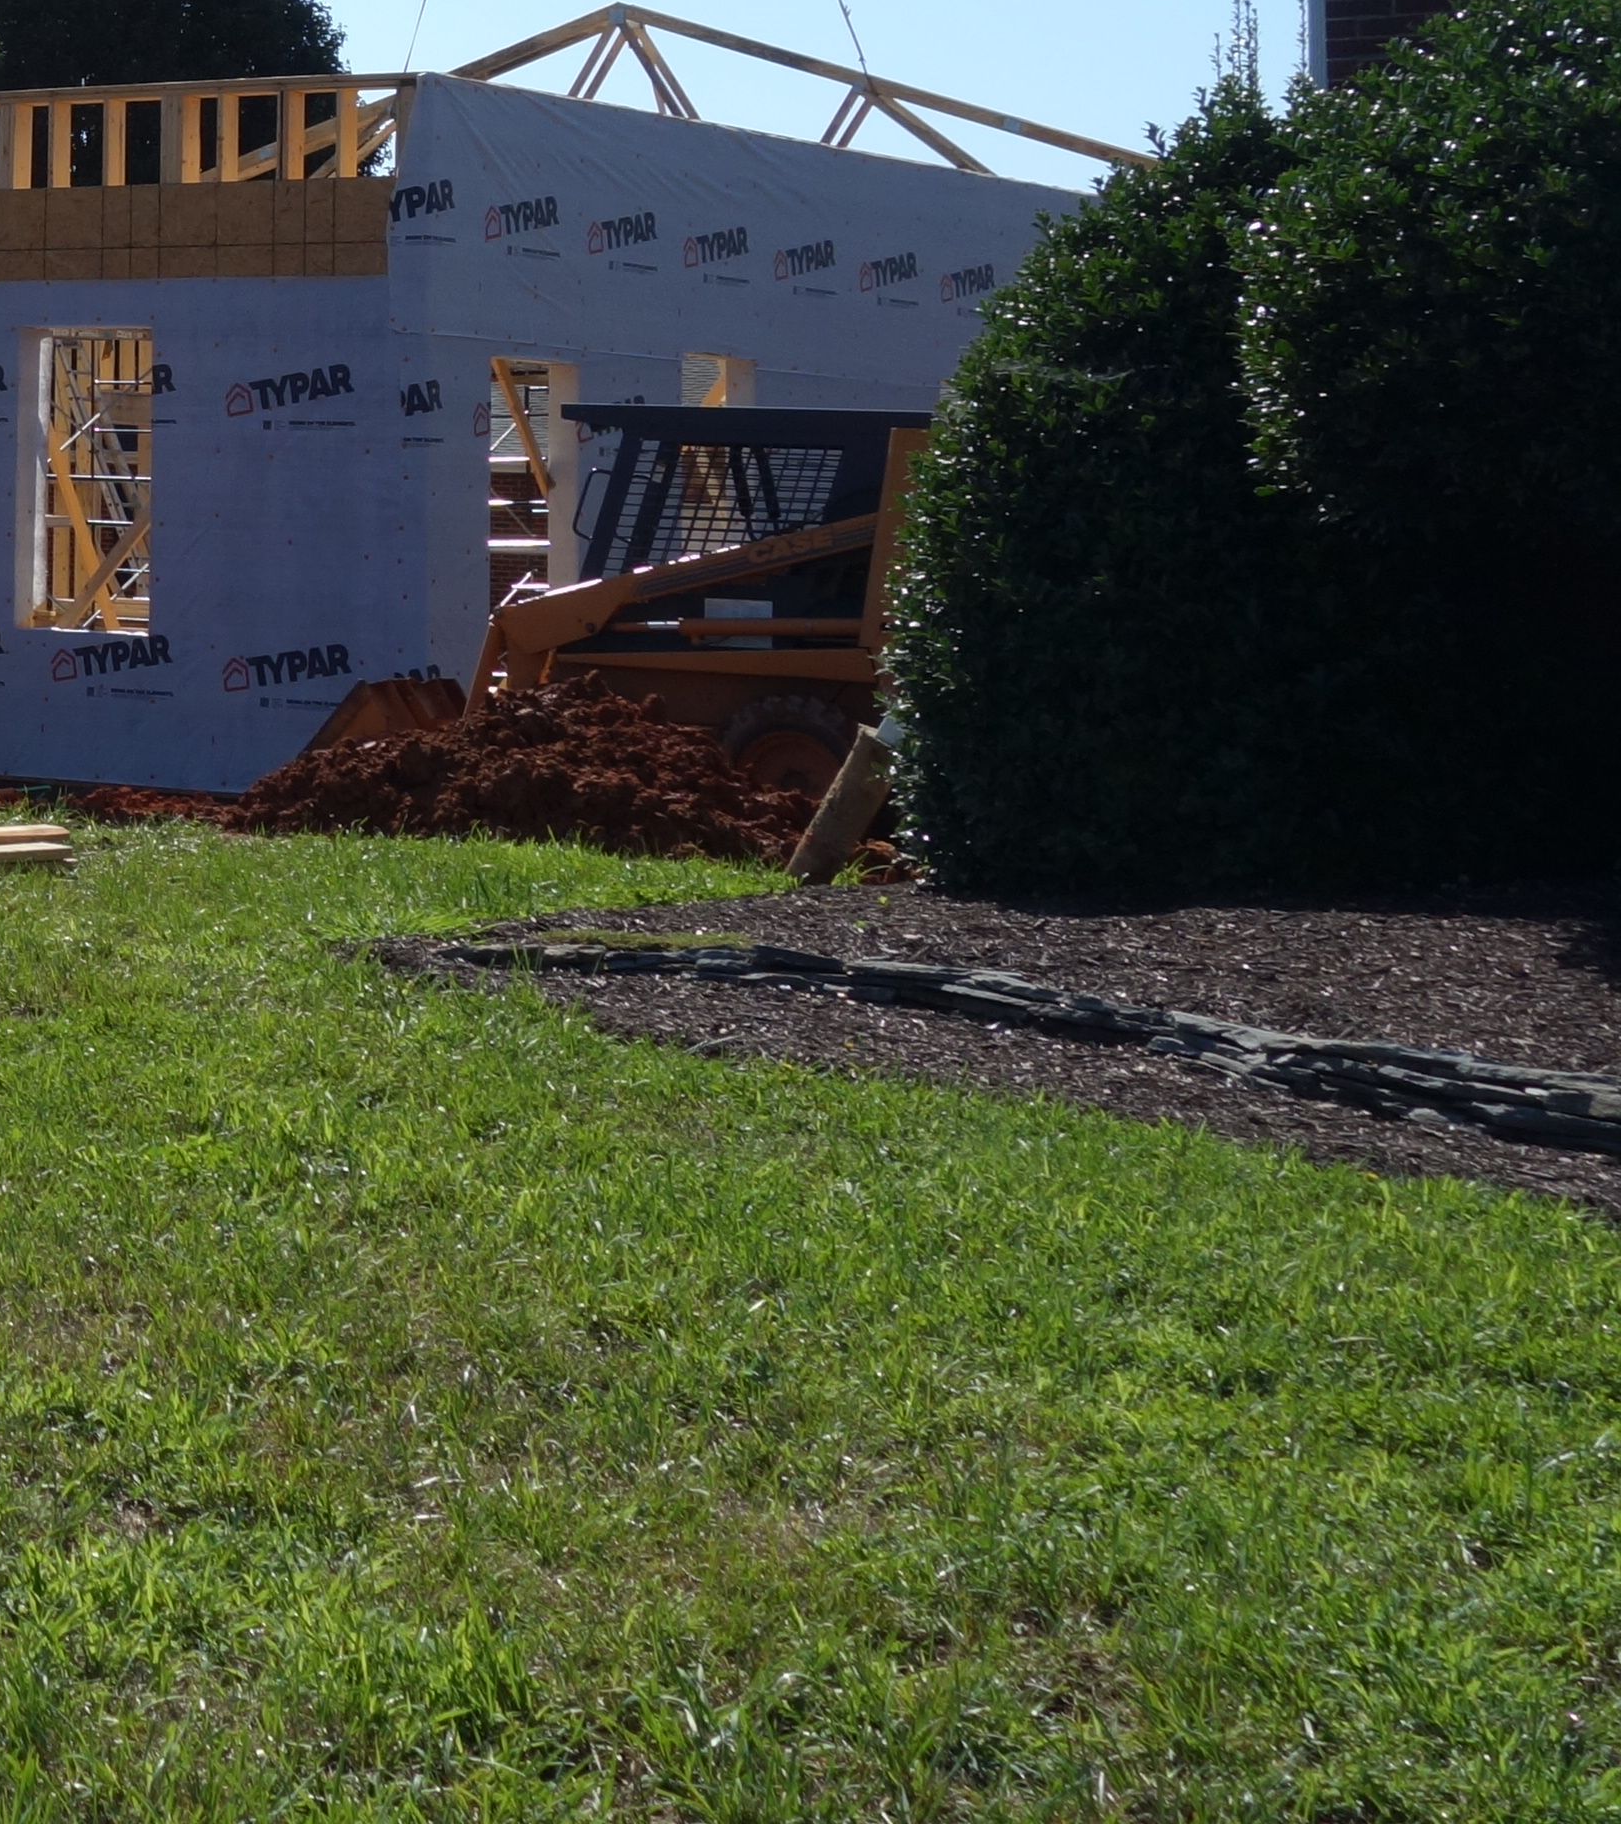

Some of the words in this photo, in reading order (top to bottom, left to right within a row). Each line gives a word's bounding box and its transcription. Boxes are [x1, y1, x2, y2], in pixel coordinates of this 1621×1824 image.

[499, 195, 560, 235] TYPAR
[602, 211, 658, 250] TYPAR
[695, 226, 748, 264] TYPAR
[786, 239, 836, 276] TYPAR
[871, 251, 918, 288] TYPAR
[953, 263, 996, 299] TYPAR
[247, 363, 356, 410] TYPAR
[747, 530, 835, 564] CASE
[72, 634, 173, 677] TYPAR
[245, 643, 353, 687] TYPAR
